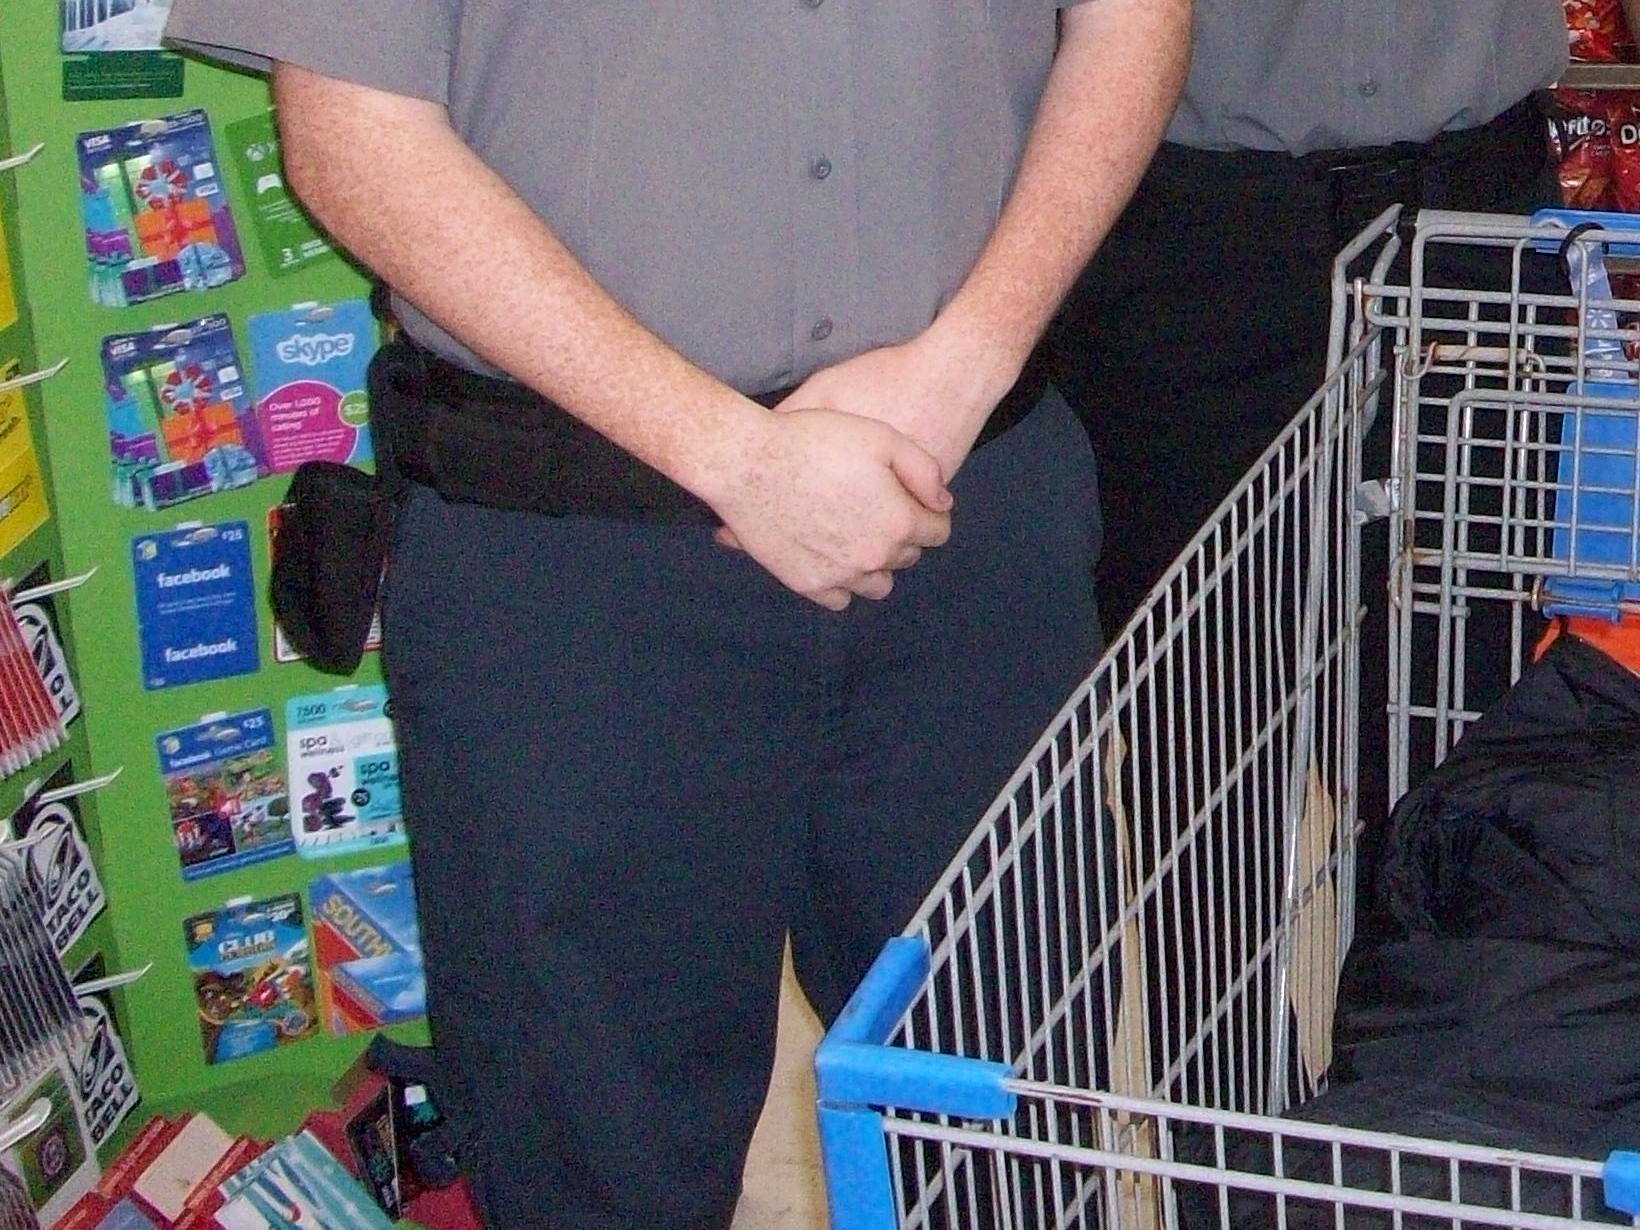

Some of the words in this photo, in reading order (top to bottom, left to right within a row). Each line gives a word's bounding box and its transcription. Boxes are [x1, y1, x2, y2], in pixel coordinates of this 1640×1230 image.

[110, 341, 136, 356] VISA
[281, 336, 350, 362] skype
[157, 563, 231, 588] facebook
[165, 638, 237, 663] facebook
[299, 734, 327, 750] spa
[85, 1063, 124, 1122] TACO
[91, 1082, 134, 1143] BELL
